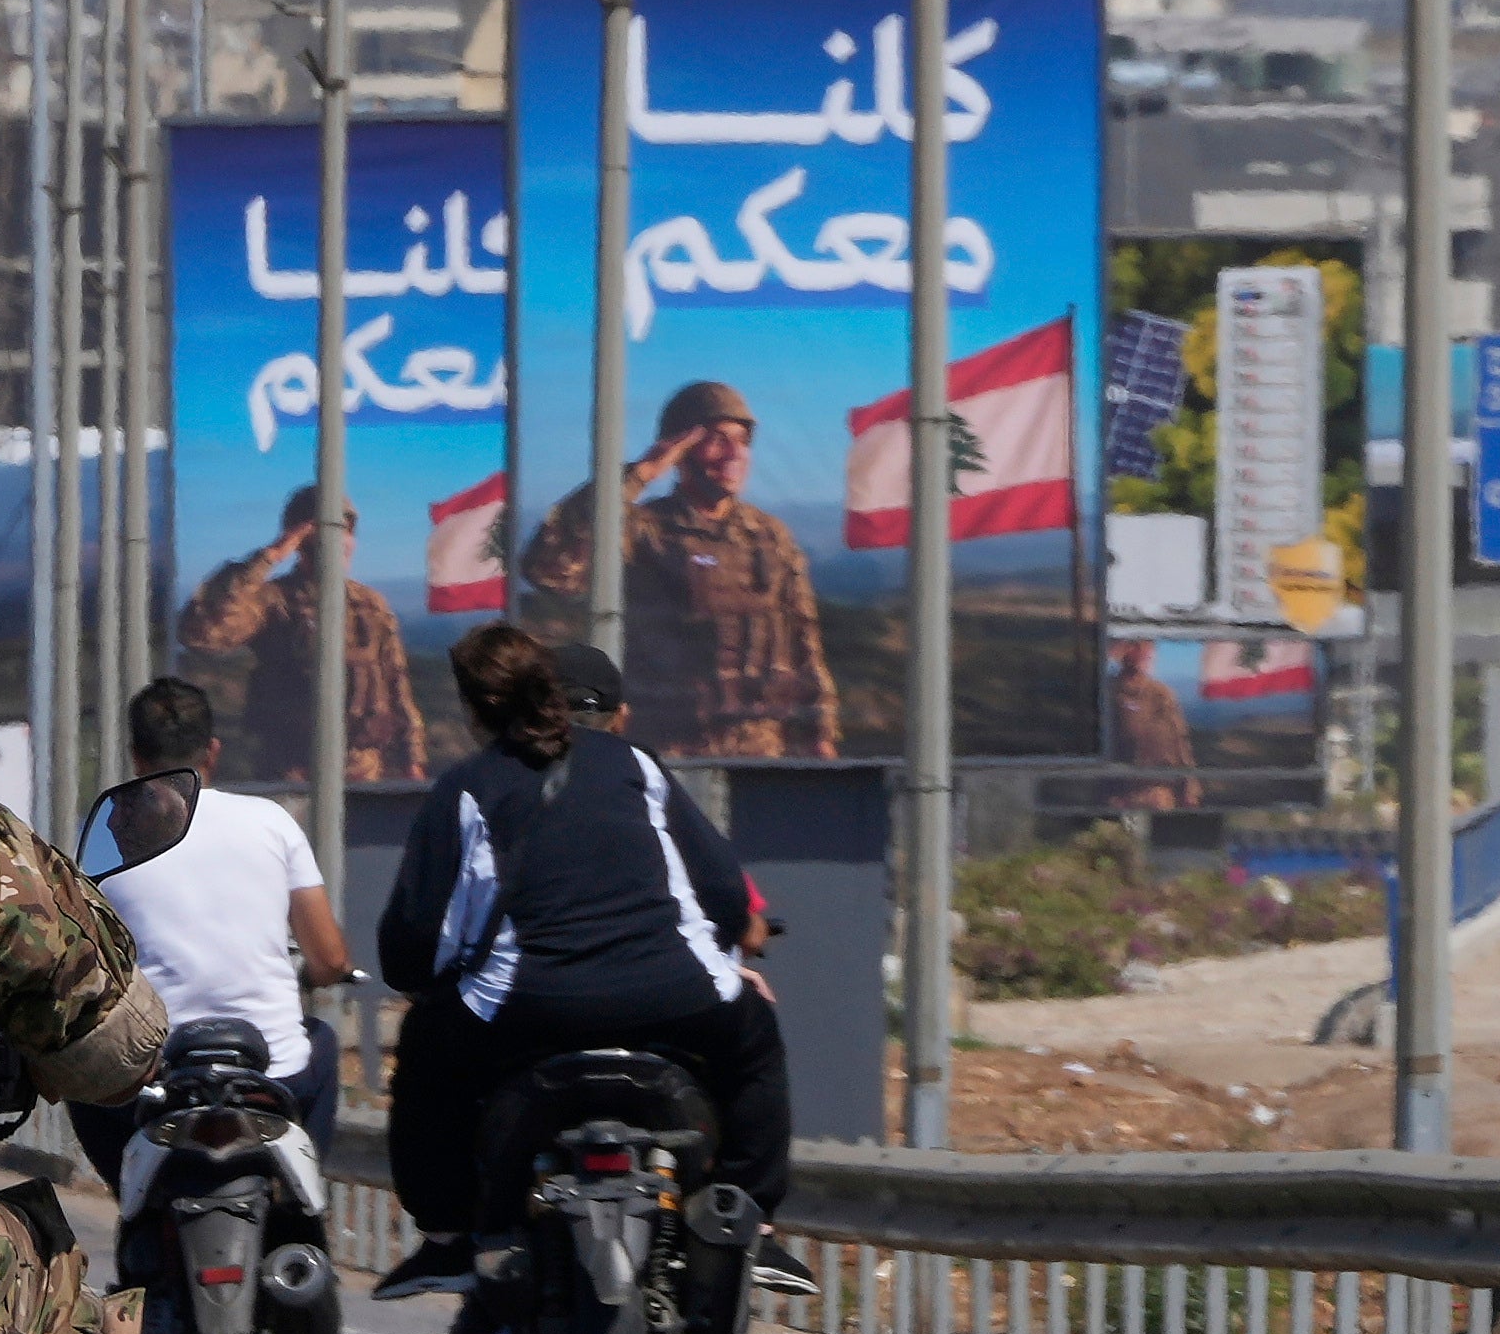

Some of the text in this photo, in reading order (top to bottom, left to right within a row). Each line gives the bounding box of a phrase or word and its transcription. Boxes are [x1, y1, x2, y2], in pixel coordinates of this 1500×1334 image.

[625, 13, 999, 145] كلنا
[622, 166, 996, 342] معكم
[247, 312, 507, 453] عكم
